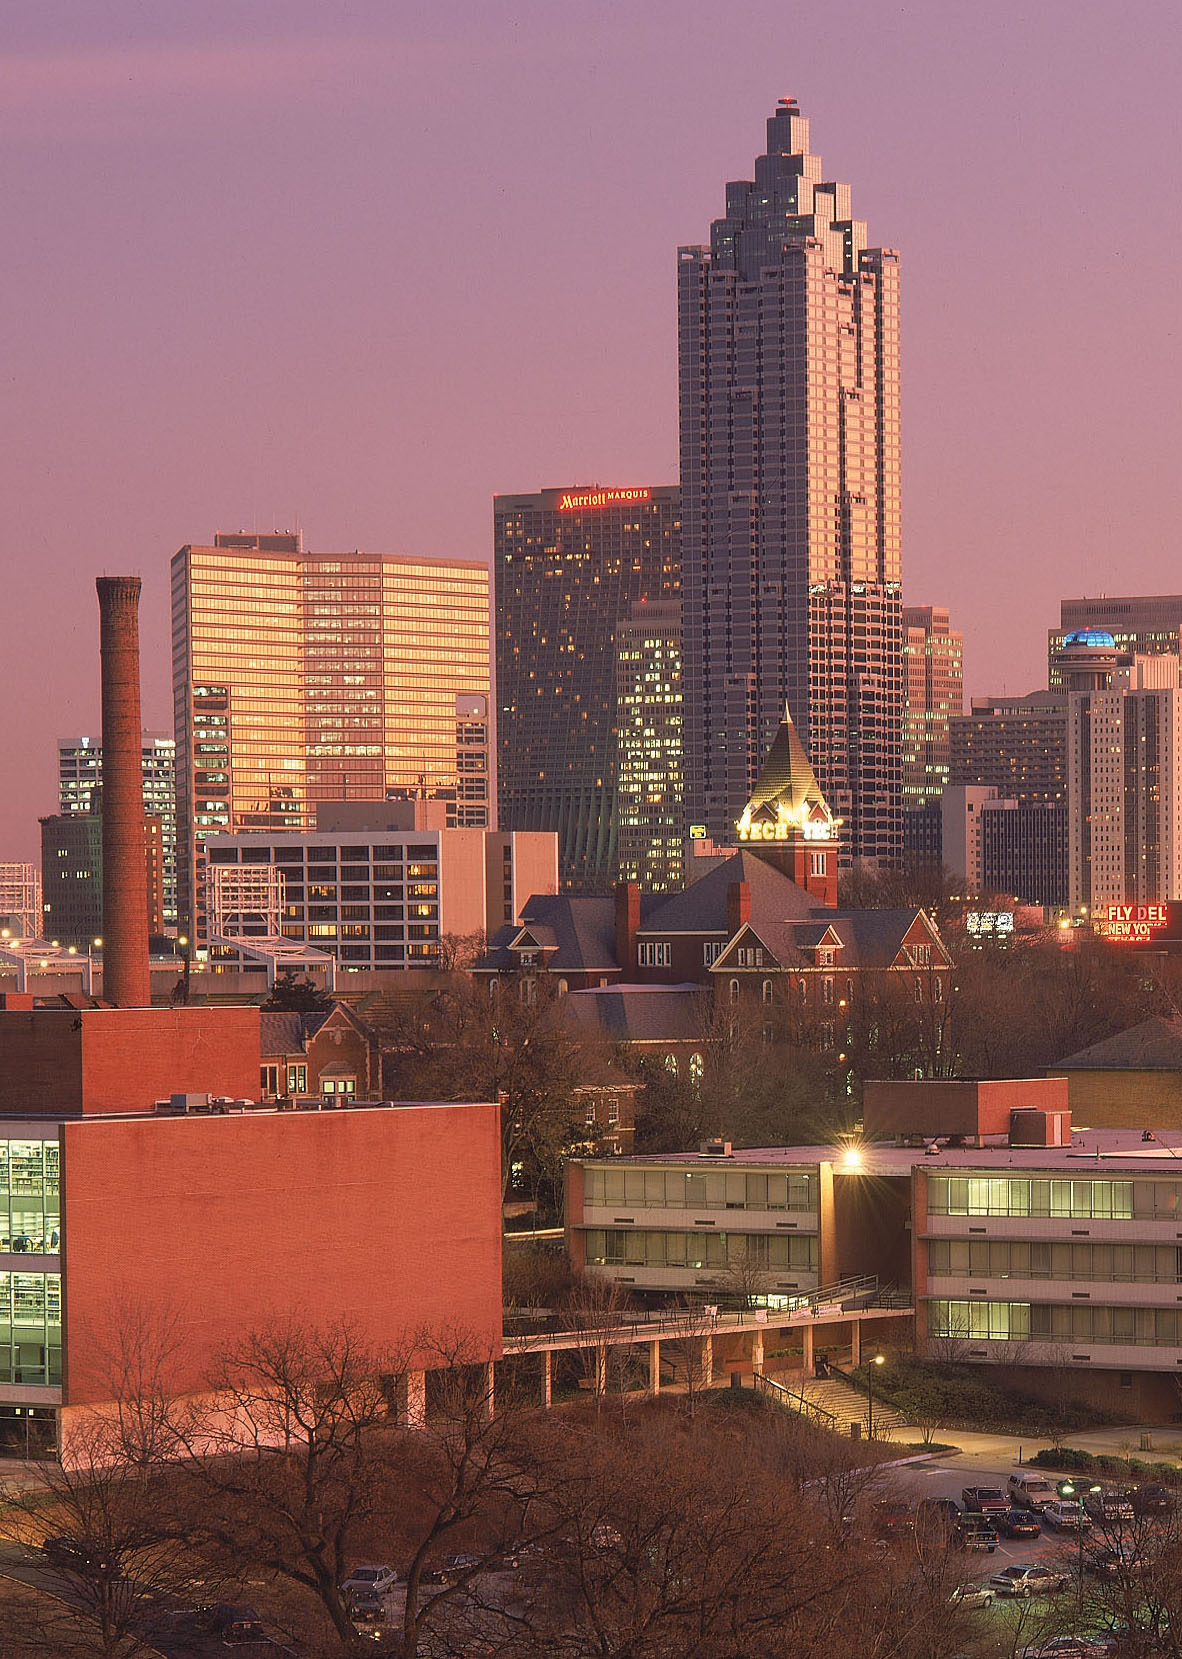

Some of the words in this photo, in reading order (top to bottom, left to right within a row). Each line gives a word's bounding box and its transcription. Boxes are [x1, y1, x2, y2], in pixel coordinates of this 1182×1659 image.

[559, 493, 606, 510] Marriott
[607, 489, 649, 500] MARQUIS
[736, 821, 789, 841] TECH
[1108, 906, 1133, 921] FLY
[1137, 906, 1168, 921] DEL
[1108, 923, 1131, 935] NEW
